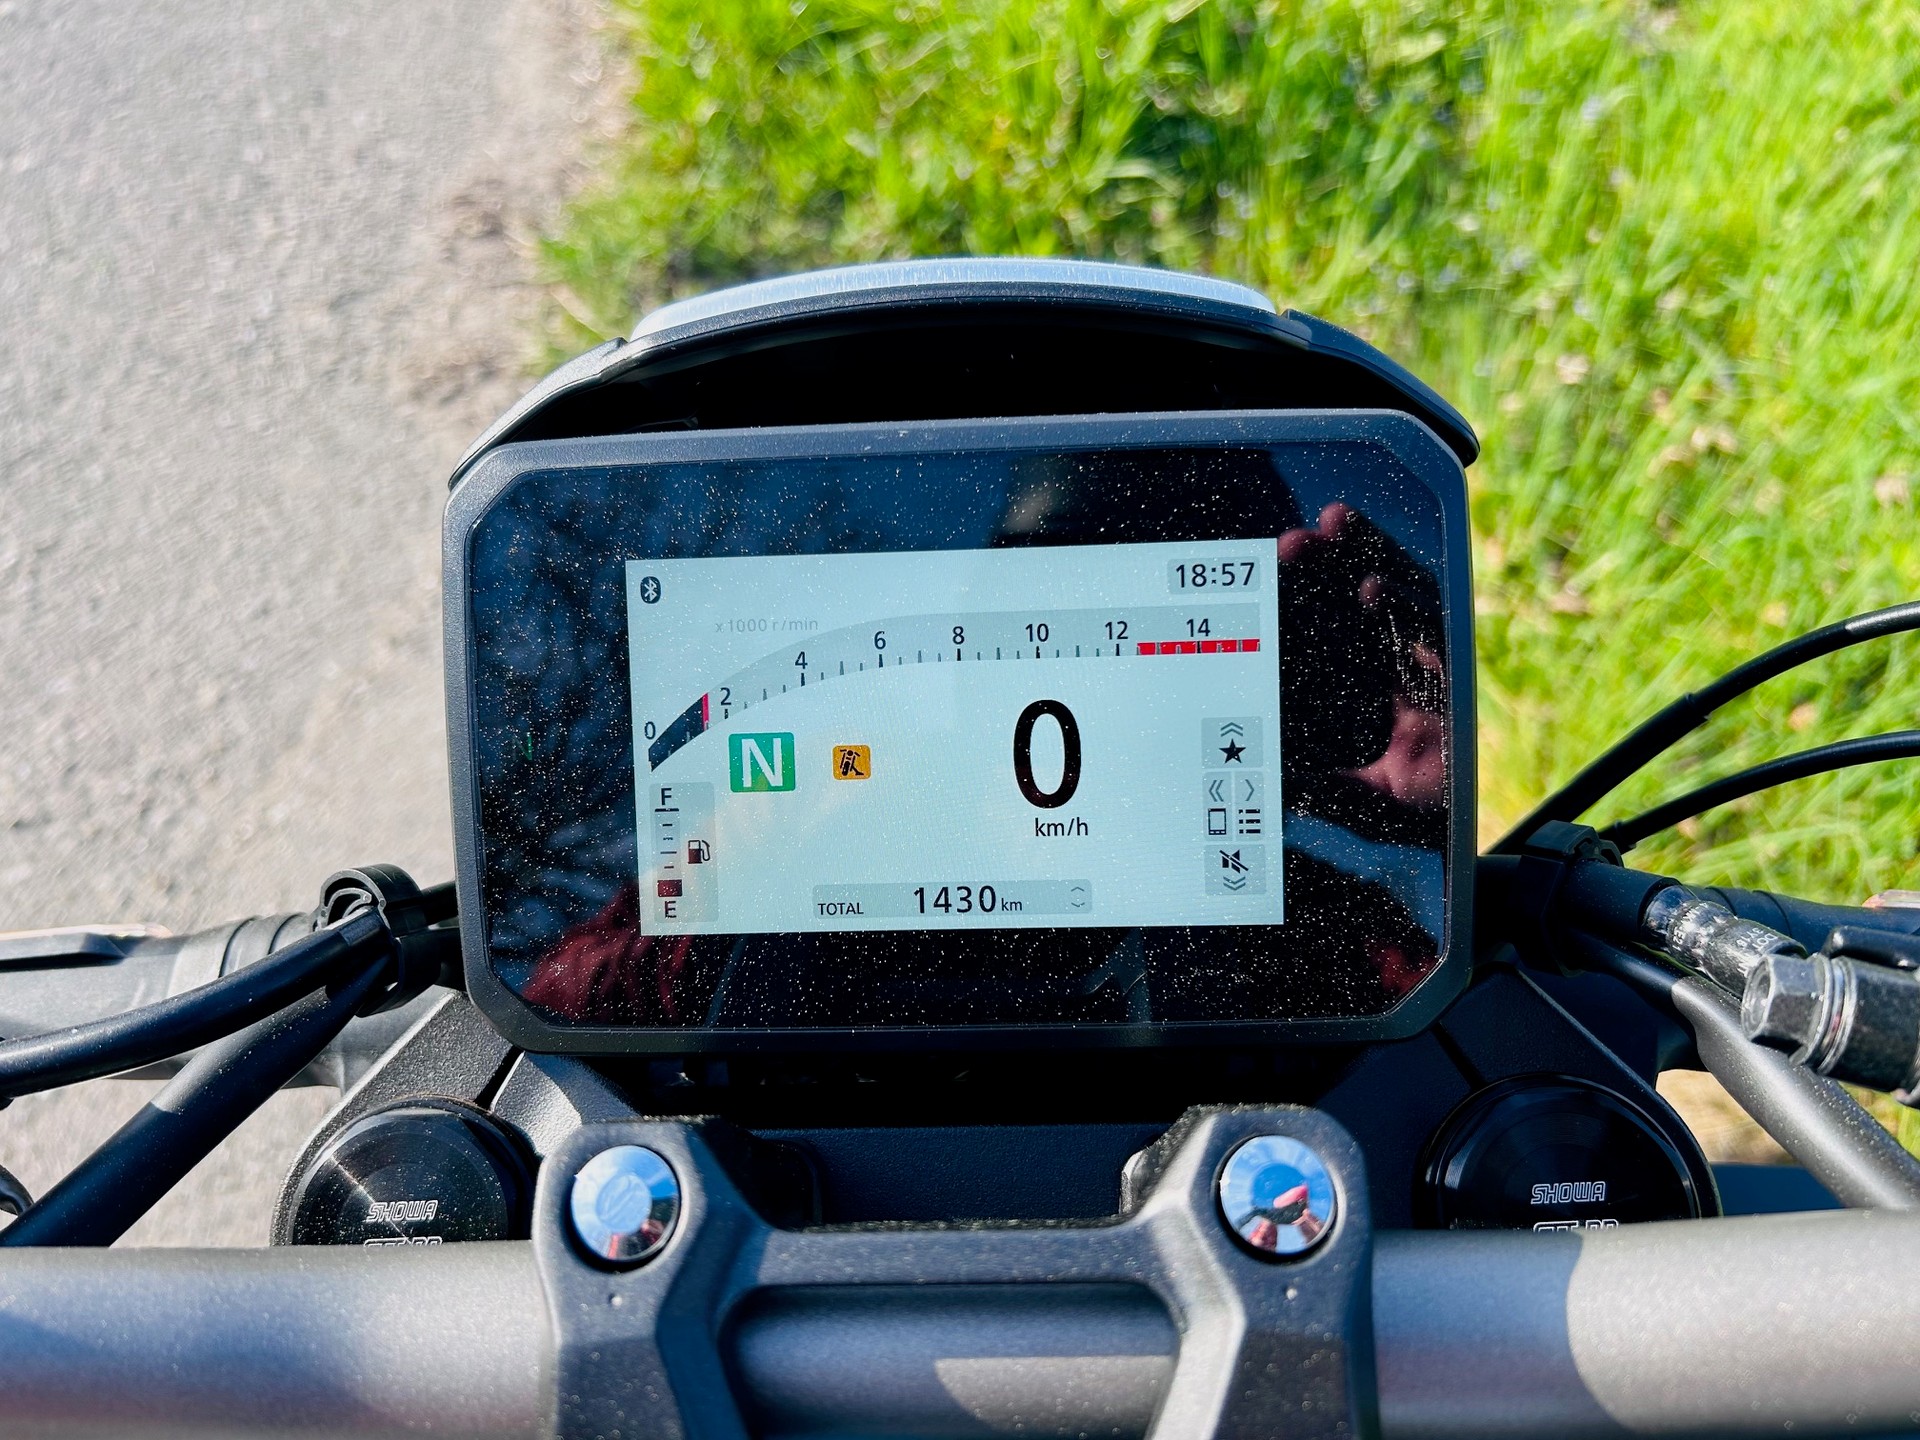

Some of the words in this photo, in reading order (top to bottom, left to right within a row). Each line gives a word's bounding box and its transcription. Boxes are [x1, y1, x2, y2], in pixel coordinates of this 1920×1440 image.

[1175, 562, 1255, 588] 18:57
[715, 618, 768, 633] x1000
[772, 616, 819, 632] r/min
[1025, 623, 1049, 642] 10
[1105, 621, 1128, 640] 12
[1186, 619, 1211, 637] 14
[874, 631, 887, 650] 6
[952, 626, 965, 645] 8
[794, 651, 808, 669] 4
[720, 687, 732, 705] 2
[644, 721, 656, 739] 0
[741, 737, 783, 787] N
[1013, 699, 1081, 809] 0
[661, 788, 673, 805] F
[1035, 817, 1089, 837] km/h
[664, 901, 677, 918] E
[818, 902, 864, 916] TOTAL
[914, 885, 997, 914] 1430
[1001, 898, 1023, 911] km
[1752, 933, 1778, 951] DOT
[1530, 1181, 1606, 1204] SHOWA
[366, 1199, 438, 1222] SHOWA
